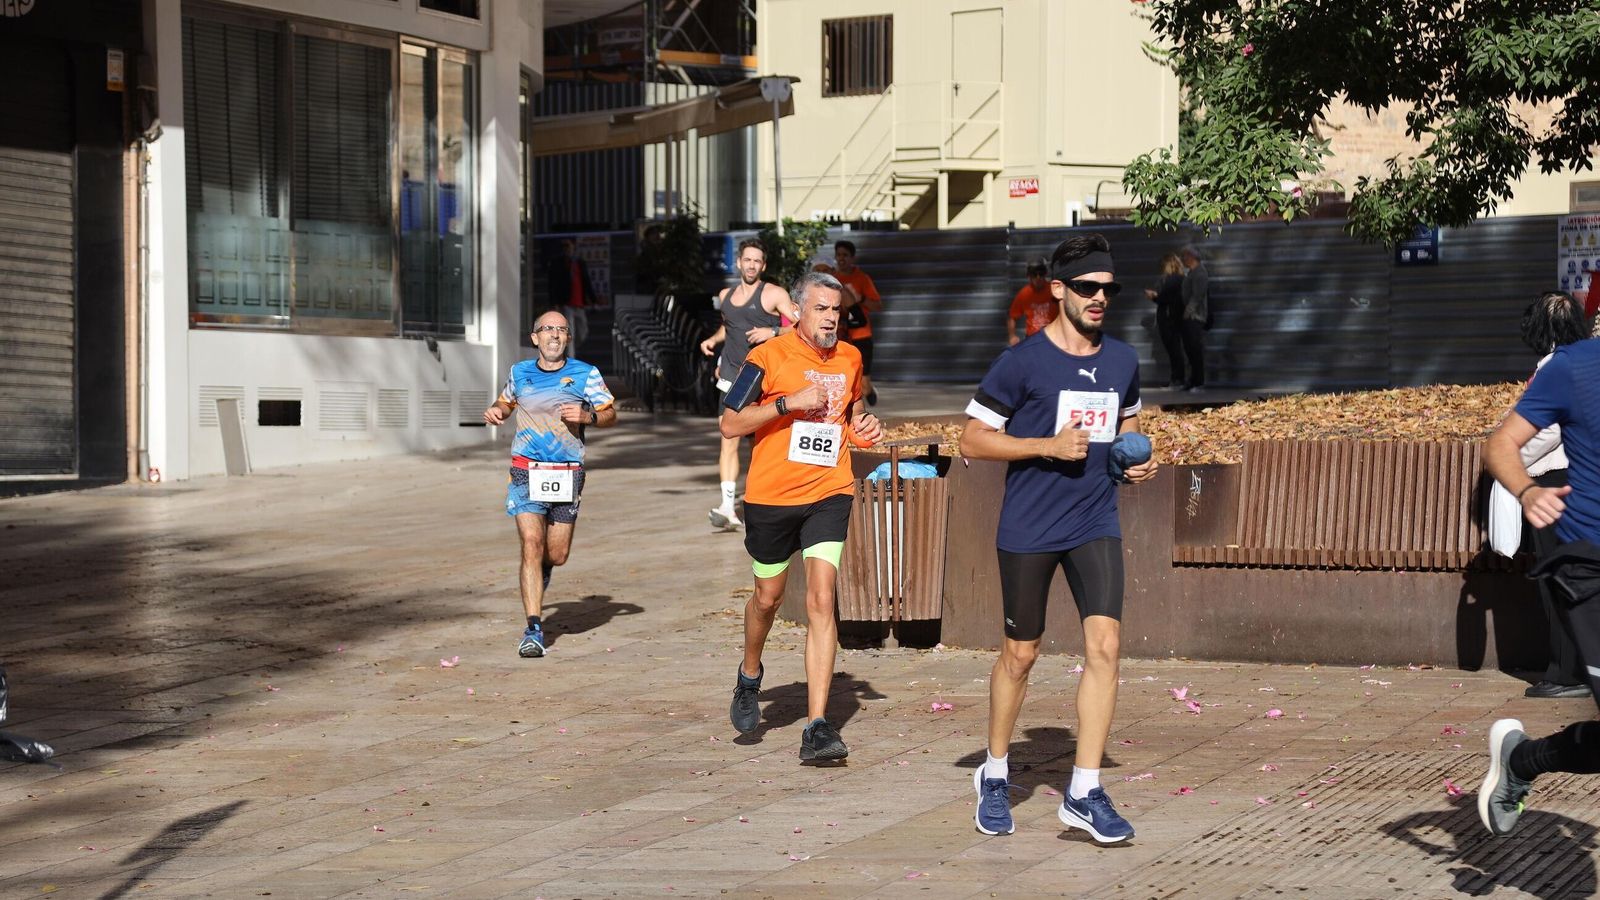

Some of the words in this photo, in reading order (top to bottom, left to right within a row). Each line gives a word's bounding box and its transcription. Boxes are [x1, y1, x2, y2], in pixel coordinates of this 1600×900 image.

[1070, 409, 1107, 427] 531
[799, 436, 832, 452] 862
[541, 481, 560, 492] 60
